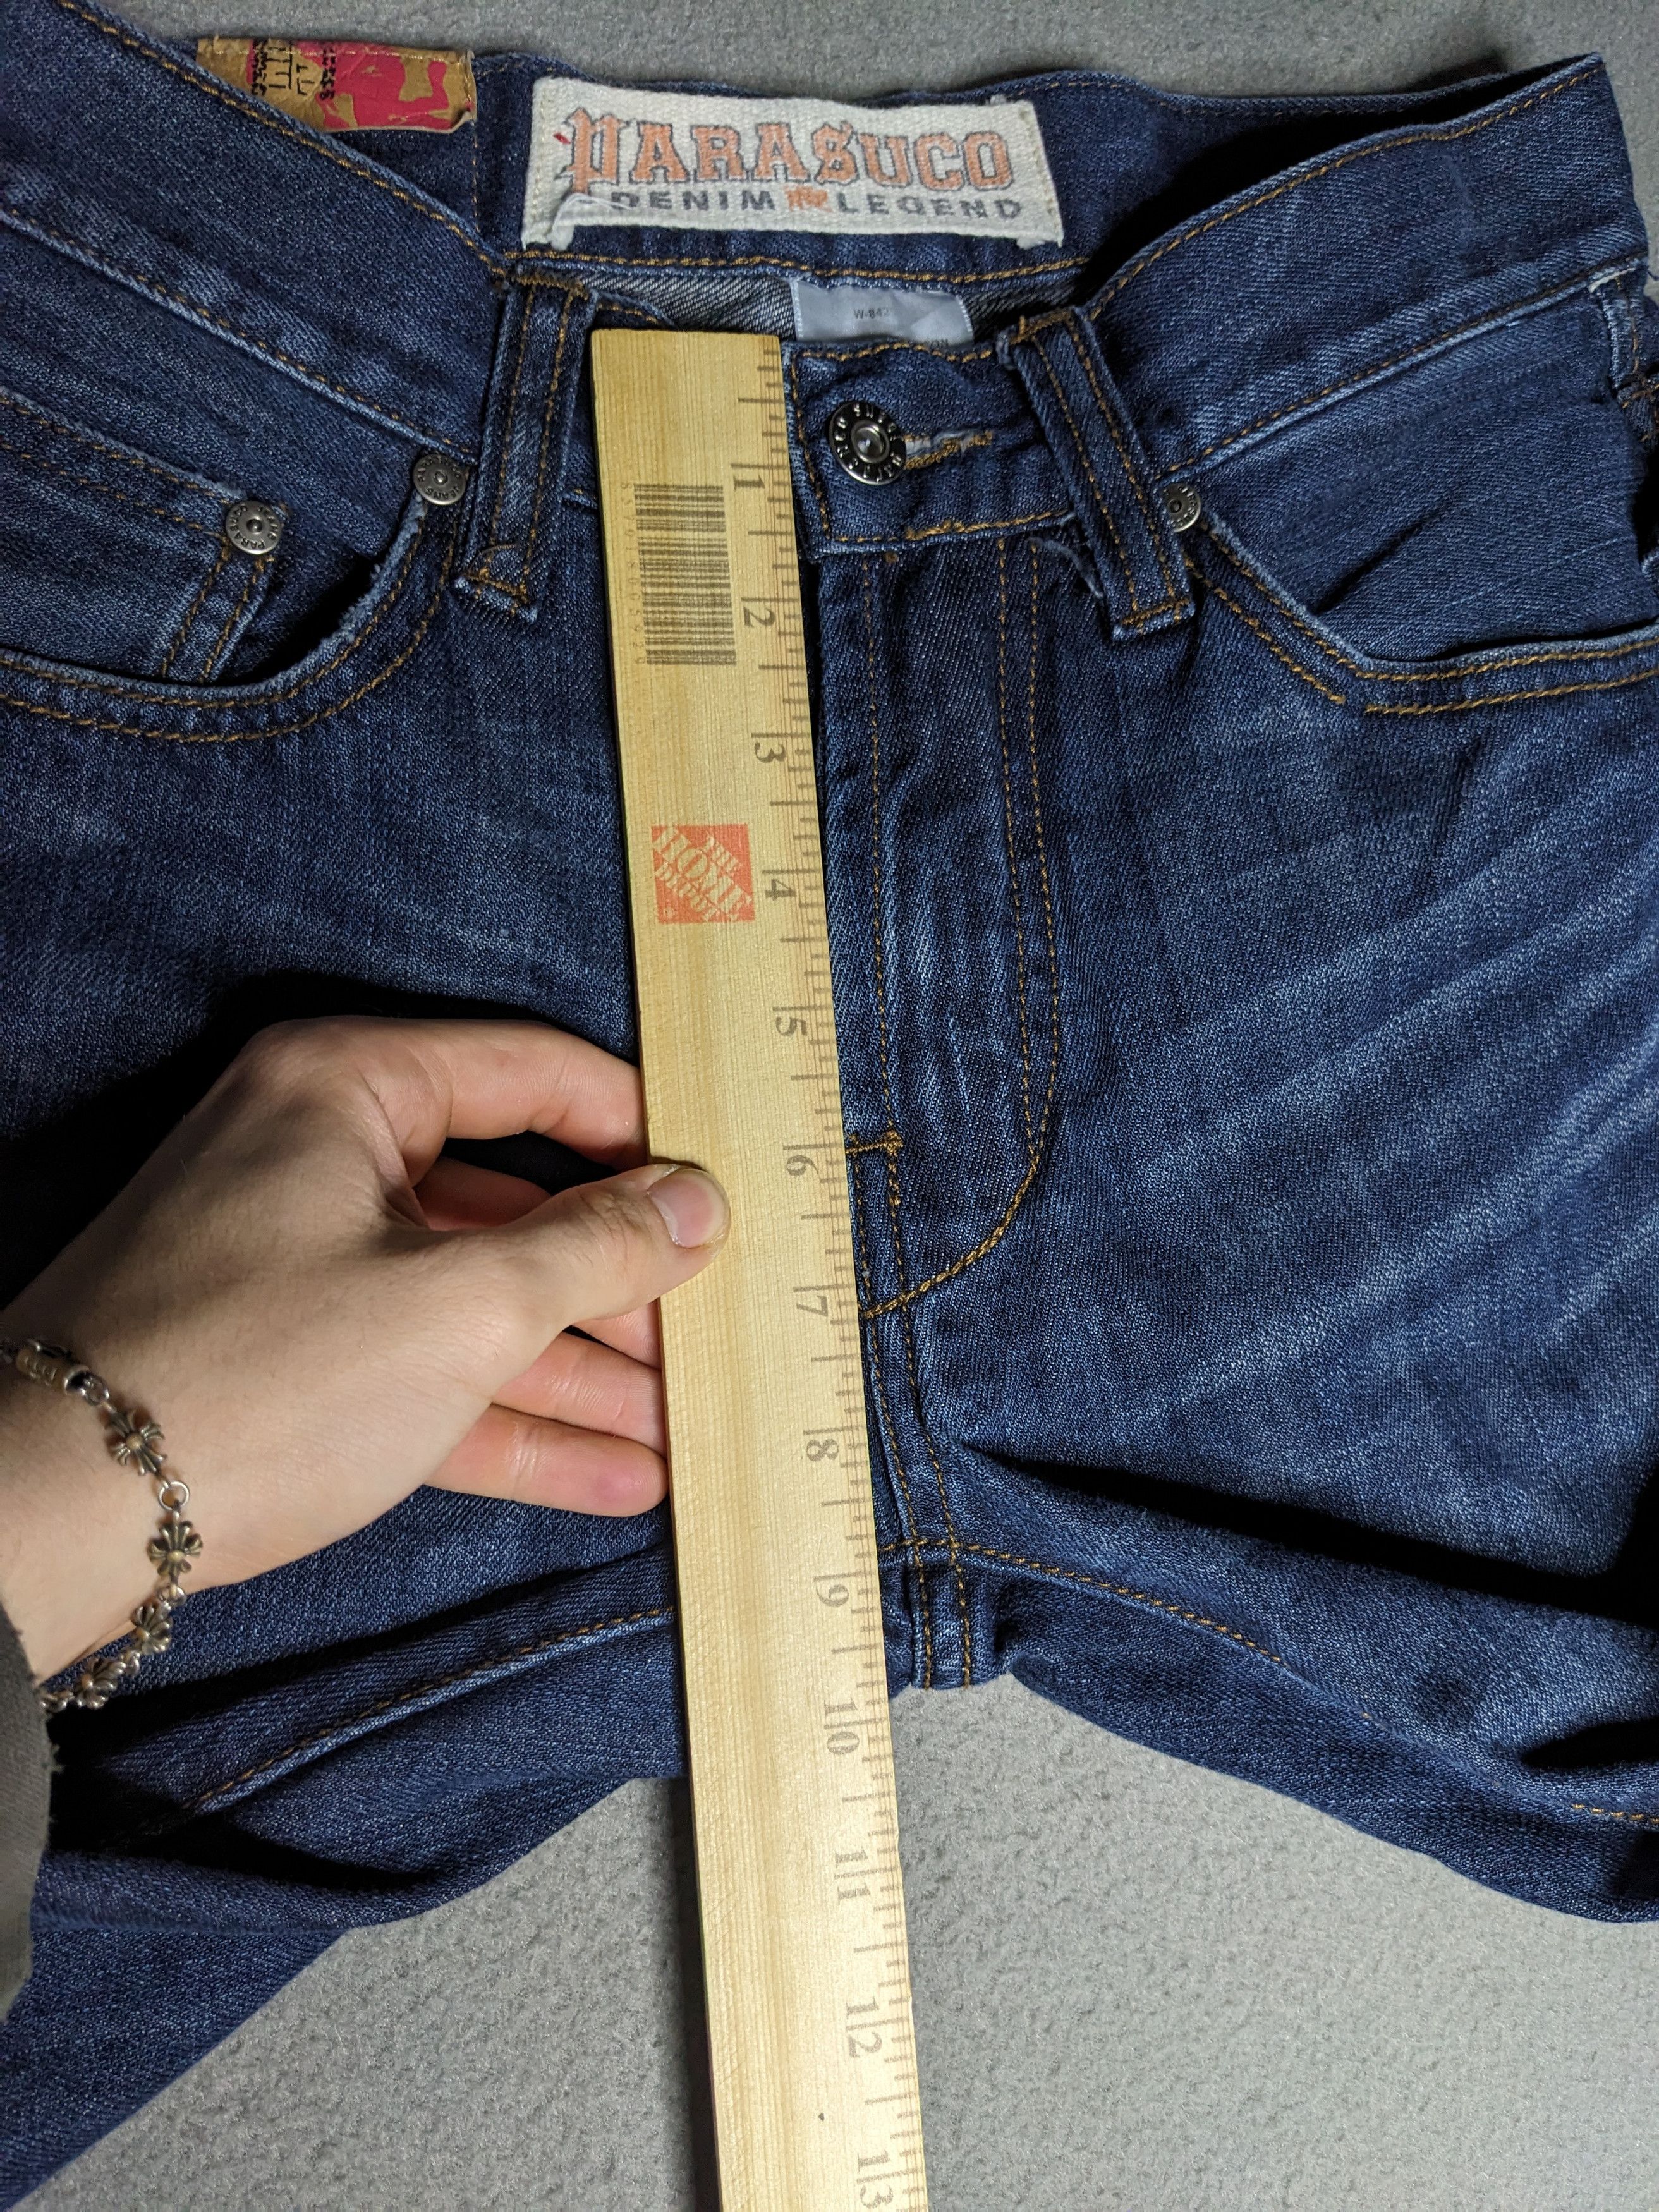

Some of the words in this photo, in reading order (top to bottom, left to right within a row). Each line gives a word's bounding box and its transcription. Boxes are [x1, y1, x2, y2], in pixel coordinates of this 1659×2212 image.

[554, 107, 1014, 194] PARASUCO
[611, 191, 776, 211] DENIM
[837, 192, 1023, 220] LEGEND
[733, 475, 765, 490] 1
[744, 605, 775, 629] 2
[755, 742, 787, 763] 3
[653, 827, 753, 920] HOME
[655, 861, 719, 921] DEPOT
[765, 878, 796, 901] 4
[775, 1016, 807, 1037] 5
[786, 1155, 822, 1183] 6
[796, 1296, 828, 1317] 7
[806, 1439, 839, 1462] 8
[815, 1584, 849, 1608] 9
[824, 1699, 860, 1755] 10
[835, 1846, 871, 1902] 11
[846, 1996, 883, 2060] 12
[857, 2149, 894, 2210] 13
